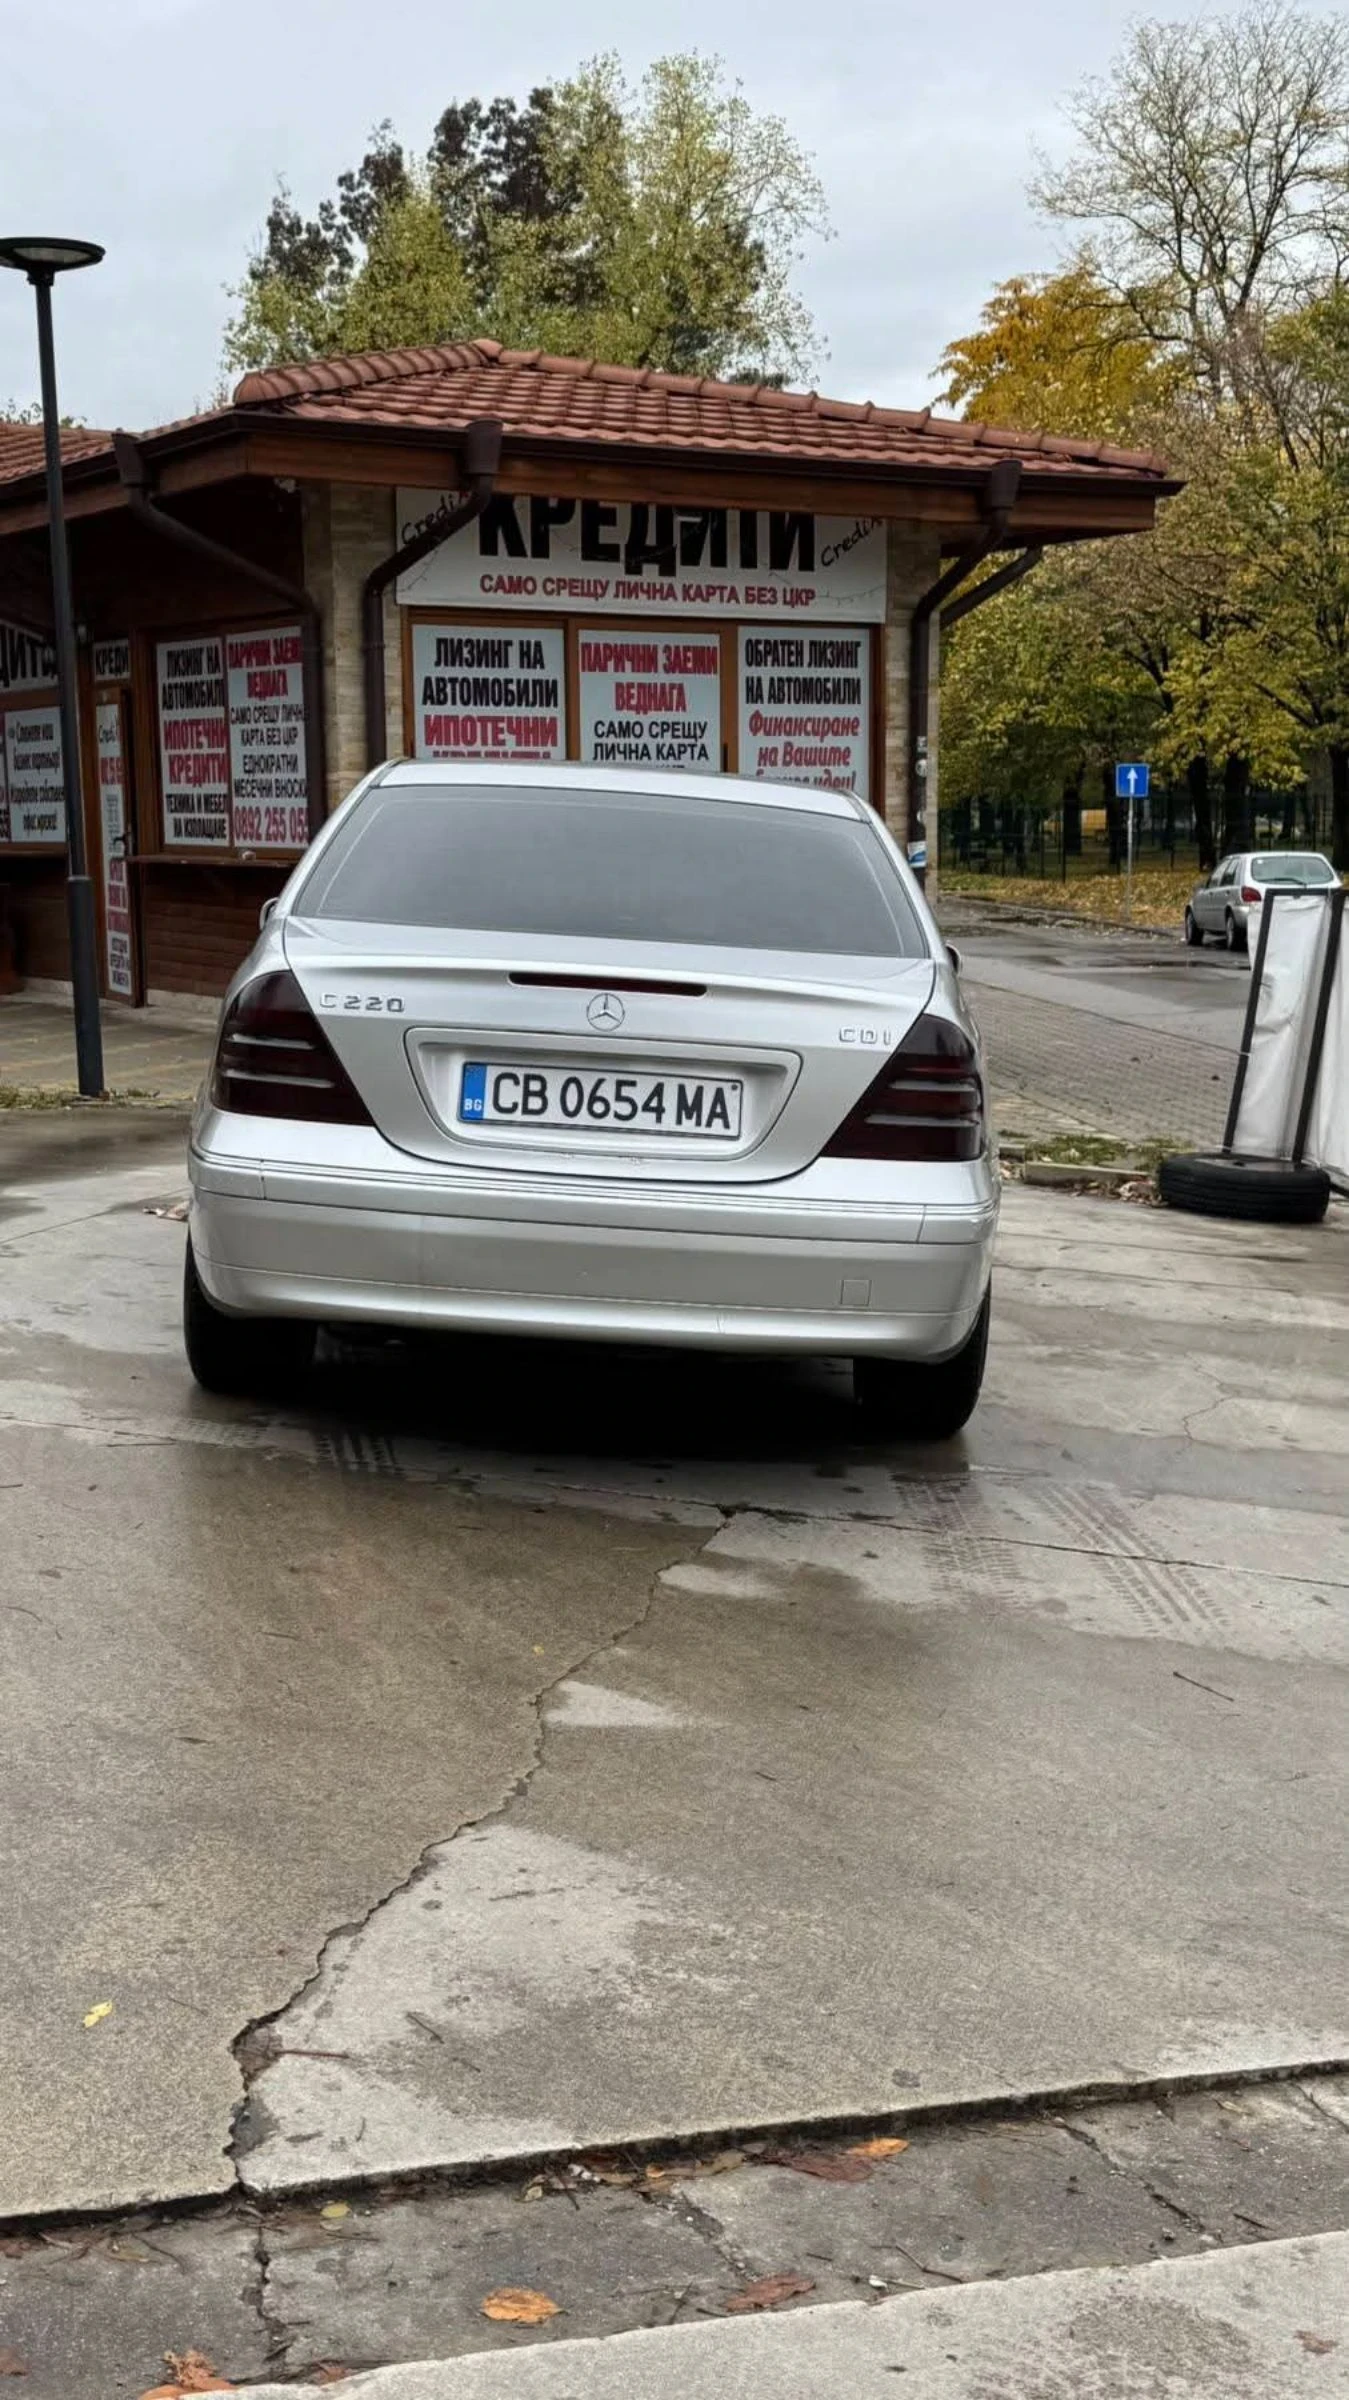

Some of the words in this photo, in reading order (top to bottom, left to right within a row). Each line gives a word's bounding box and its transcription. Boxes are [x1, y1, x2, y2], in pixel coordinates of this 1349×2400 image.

[480, 494, 815, 576] КРЕДИТИ
[480, 574, 537, 596] САМО
[542, 577, 609, 601] СРЕЩУ
[614, 580, 677, 602] ЛИЧНА
[682, 584, 741, 605] КАРТА
[745, 586, 778, 606] БЕЗ
[782, 588, 816, 609] ЦКР
[206, 643, 222, 675] НА
[434, 638, 513, 668] ЛИЗИНГ
[519, 640, 545, 669] НА
[580, 642, 658, 673] ПАРИЧНИ
[663, 644, 718, 675] ЗАЕМИ
[745, 638, 803, 668] ОБРАТЕН
[807, 639, 861, 668] ЛИЗИНГ
[162, 679, 225, 711] АВТОМОБИЛ
[422, 676, 558, 708] АВТОМОБИЛИ
[615, 682, 687, 715] ВЕДНАГА
[745, 676, 764, 704] НА
[768, 676, 861, 705] АВТОМОБИЛИ
[230, 706, 251, 725] САМО
[253, 704, 279, 724] СРЕЩУ
[749, 709, 860, 743] Финансиране
[241, 728, 265, 747] КАРТА
[266, 727, 281, 746] БЕЗ
[282, 726, 299, 749] ЦКР
[424, 714, 558, 747] ИПОТЕЧНИ
[594, 720, 644, 739] САМО
[648, 721, 708, 742] СРЕЩУ
[243, 753, 299, 776] ЕДНОКРАТНИ
[593, 743, 651, 761] ЛИЧНА
[656, 743, 709, 761] КАРТА
[757, 746, 778, 767] на
[782, 741, 852, 767] Вашите
[234, 778, 273, 798] МЕСЕЧНИ
[234, 806, 262, 842] 0892
[264, 806, 287, 842] 255
[319, 993, 337, 1009] C
[343, 995, 406, 1013] 220
[838, 1027, 892, 1047] CDI
[463, 1098, 482, 1111] BG
[492, 1072, 549, 1116] CB
[559, 1076, 666, 1124] 0654
[675, 1082, 731, 1130] MA
